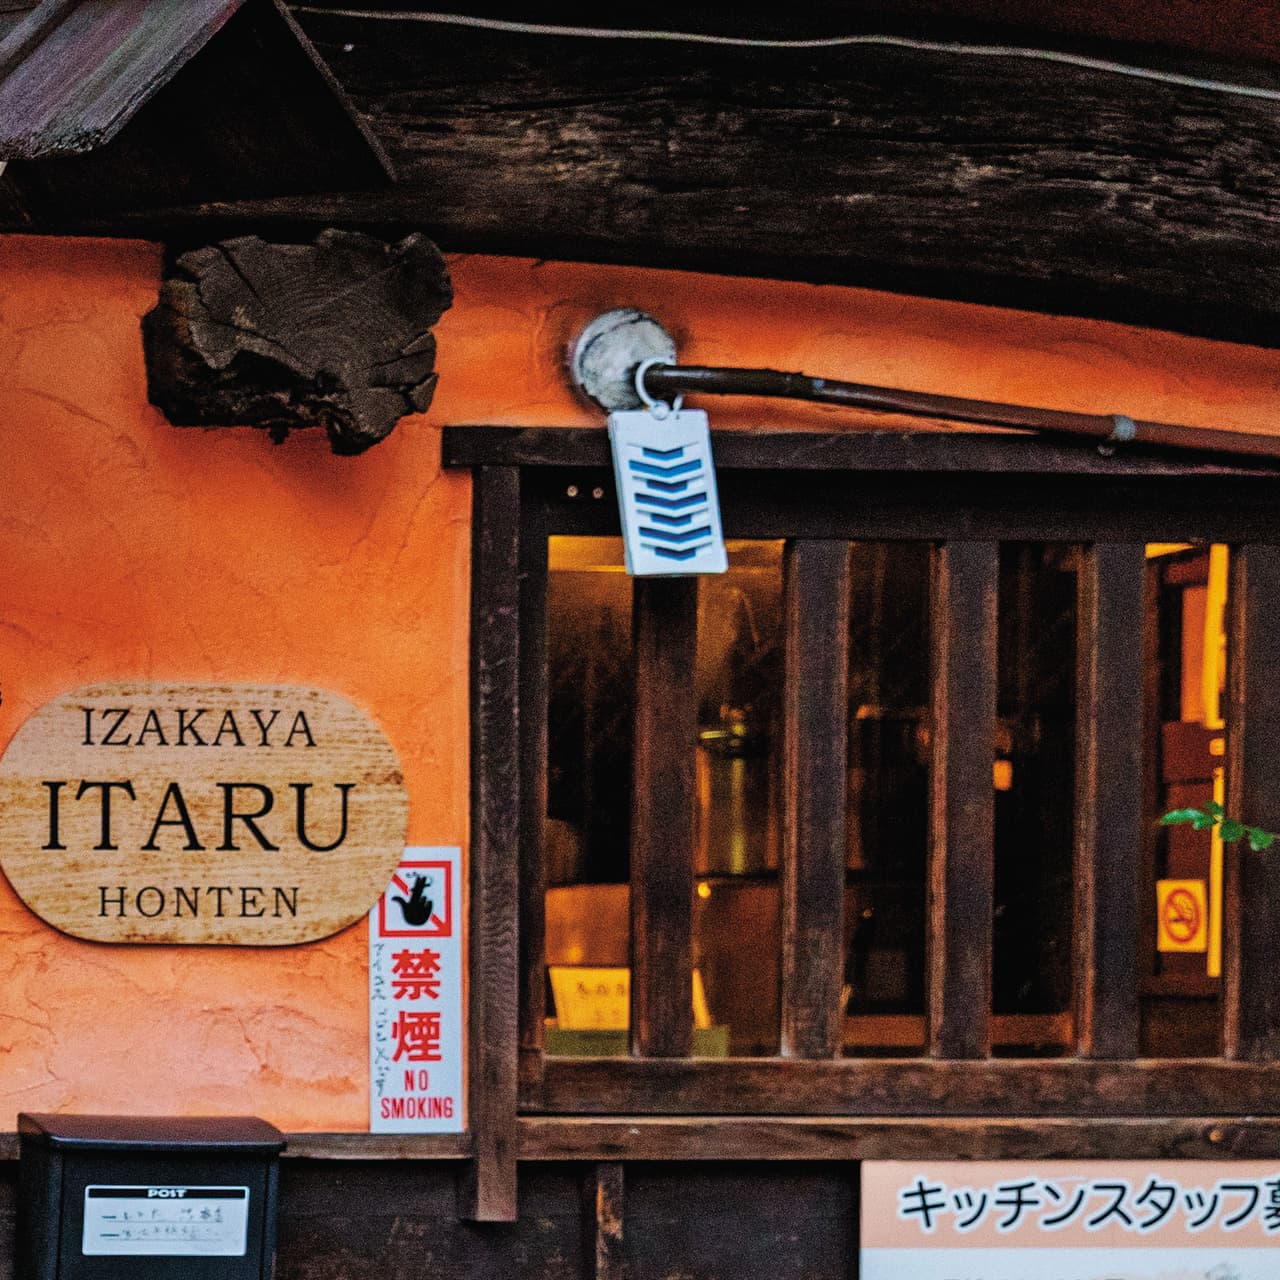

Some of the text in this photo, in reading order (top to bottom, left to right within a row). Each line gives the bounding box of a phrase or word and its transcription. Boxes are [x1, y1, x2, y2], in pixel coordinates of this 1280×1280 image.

[81, 707, 318, 749] IZAKAYA
[40, 779, 358, 853] ITARU
[98, 886, 301, 918] HONTEN
[390, 948, 443, 1064] 禁煙
[403, 1069, 430, 1092] NO
[380, 1096, 454, 1120] SMOKING
[147, 1189, 187, 1198] POST
